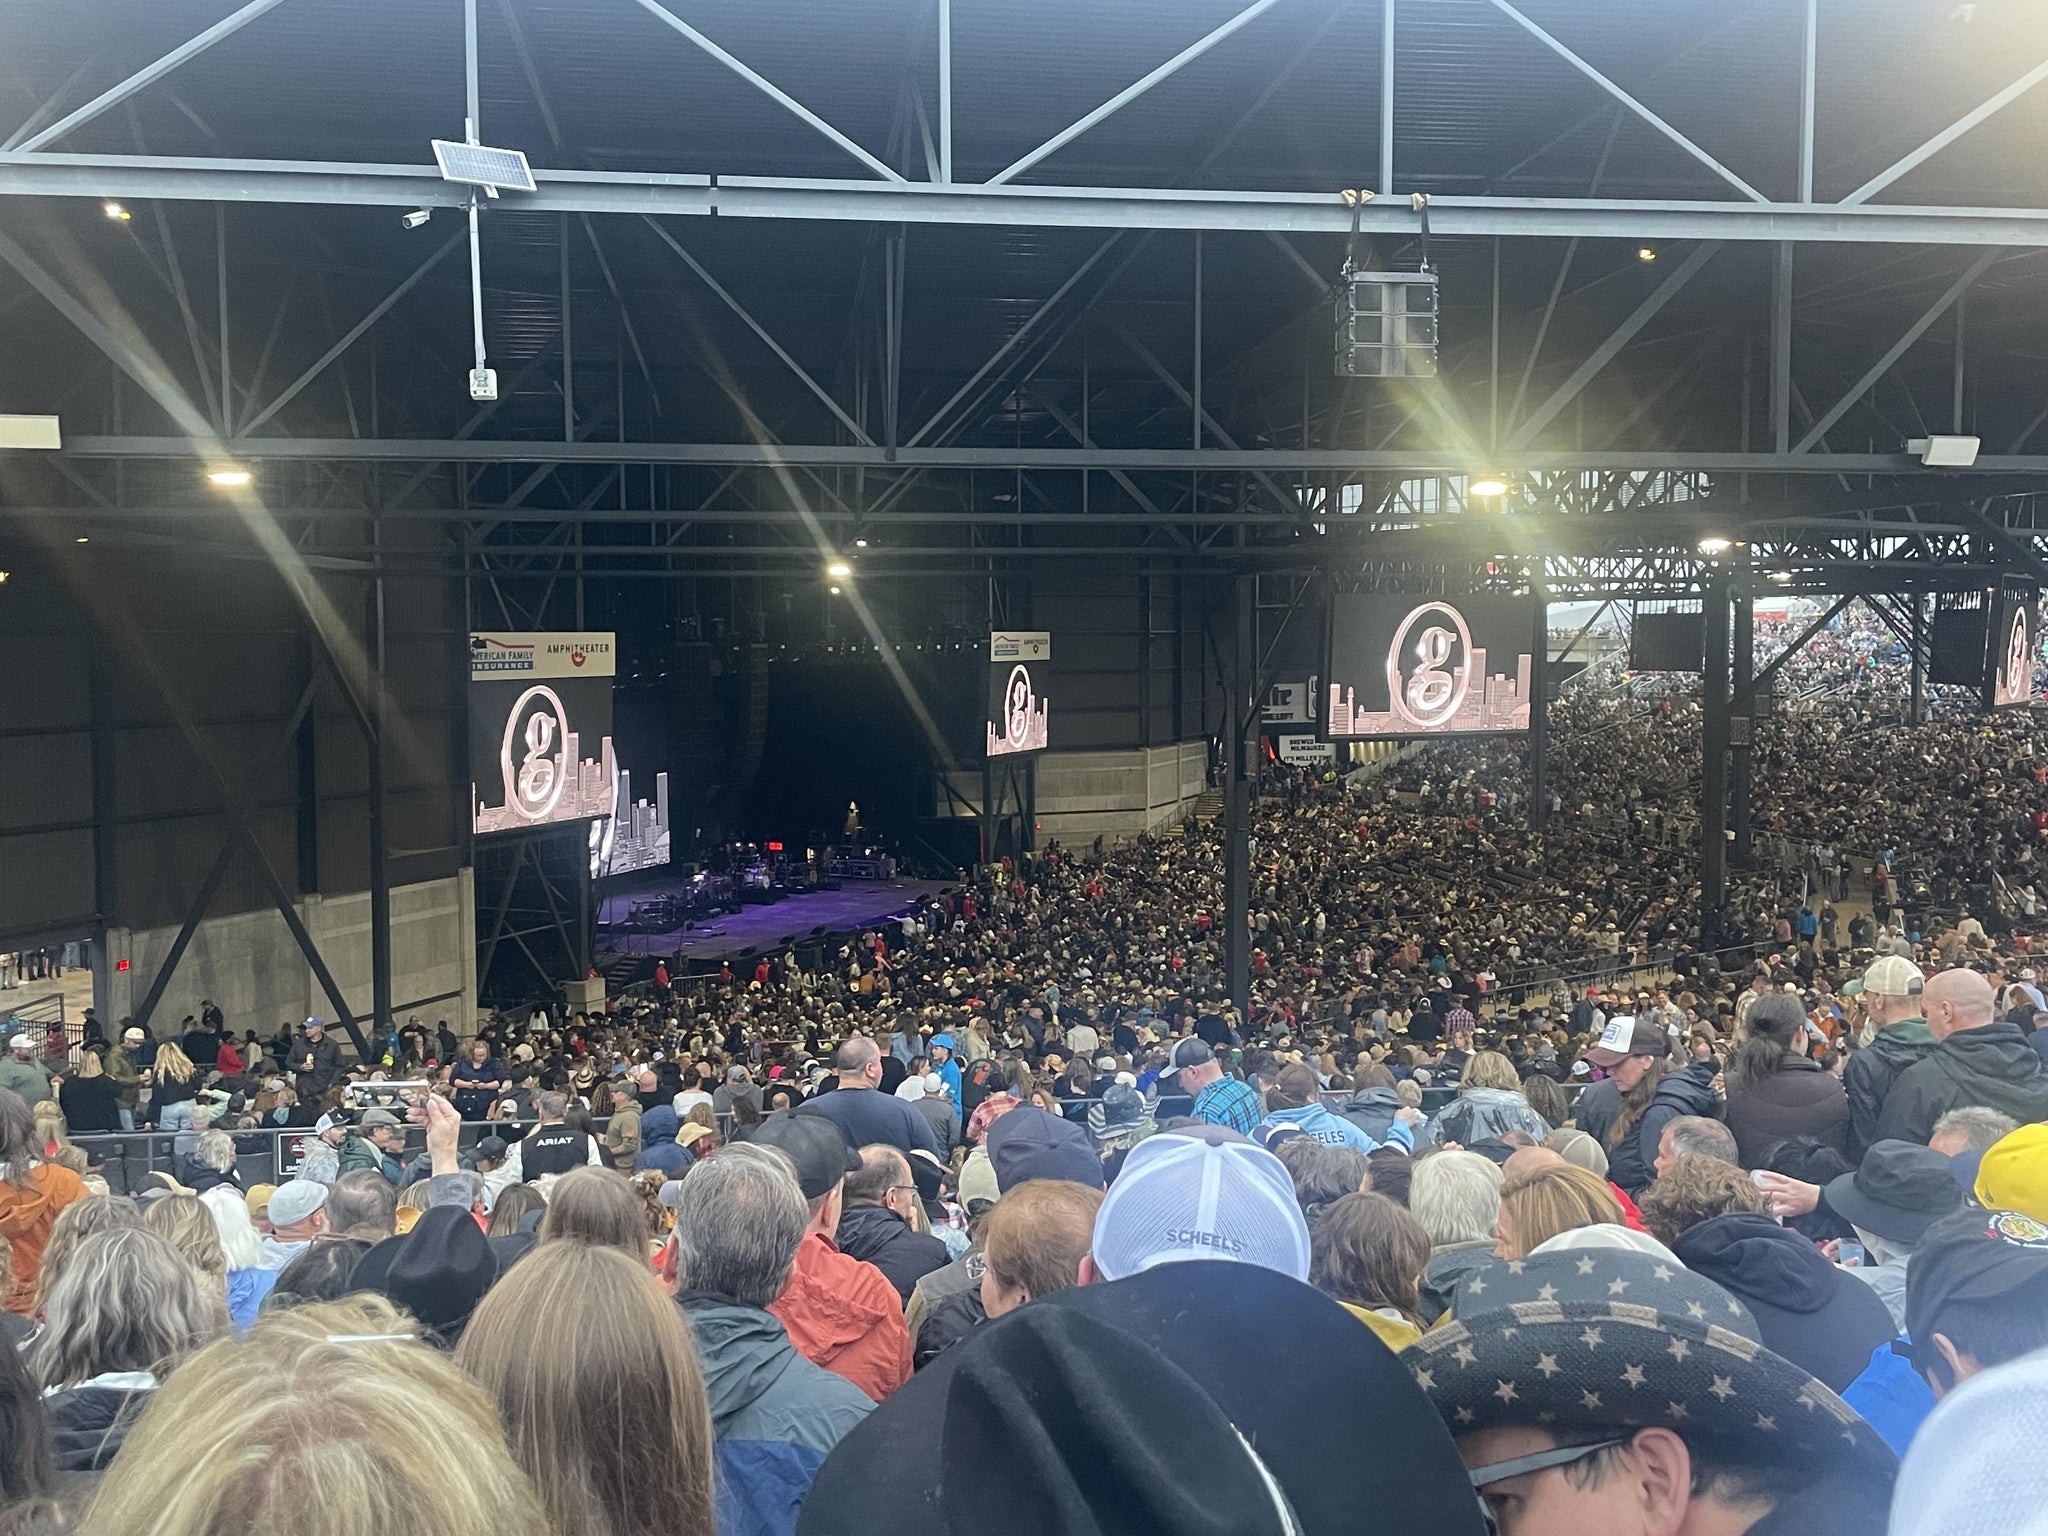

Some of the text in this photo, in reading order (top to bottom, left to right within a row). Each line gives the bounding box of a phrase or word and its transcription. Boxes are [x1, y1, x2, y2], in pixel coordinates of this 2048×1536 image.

[547, 644, 610, 654] AMPHITHEATER
[472, 651, 533, 660] MERICAN FAMILY
[472, 662, 530, 670] INSURANCE
[536, 1136, 574, 1147] ARIAT
[1166, 1229, 1243, 1253] SCHEELS
